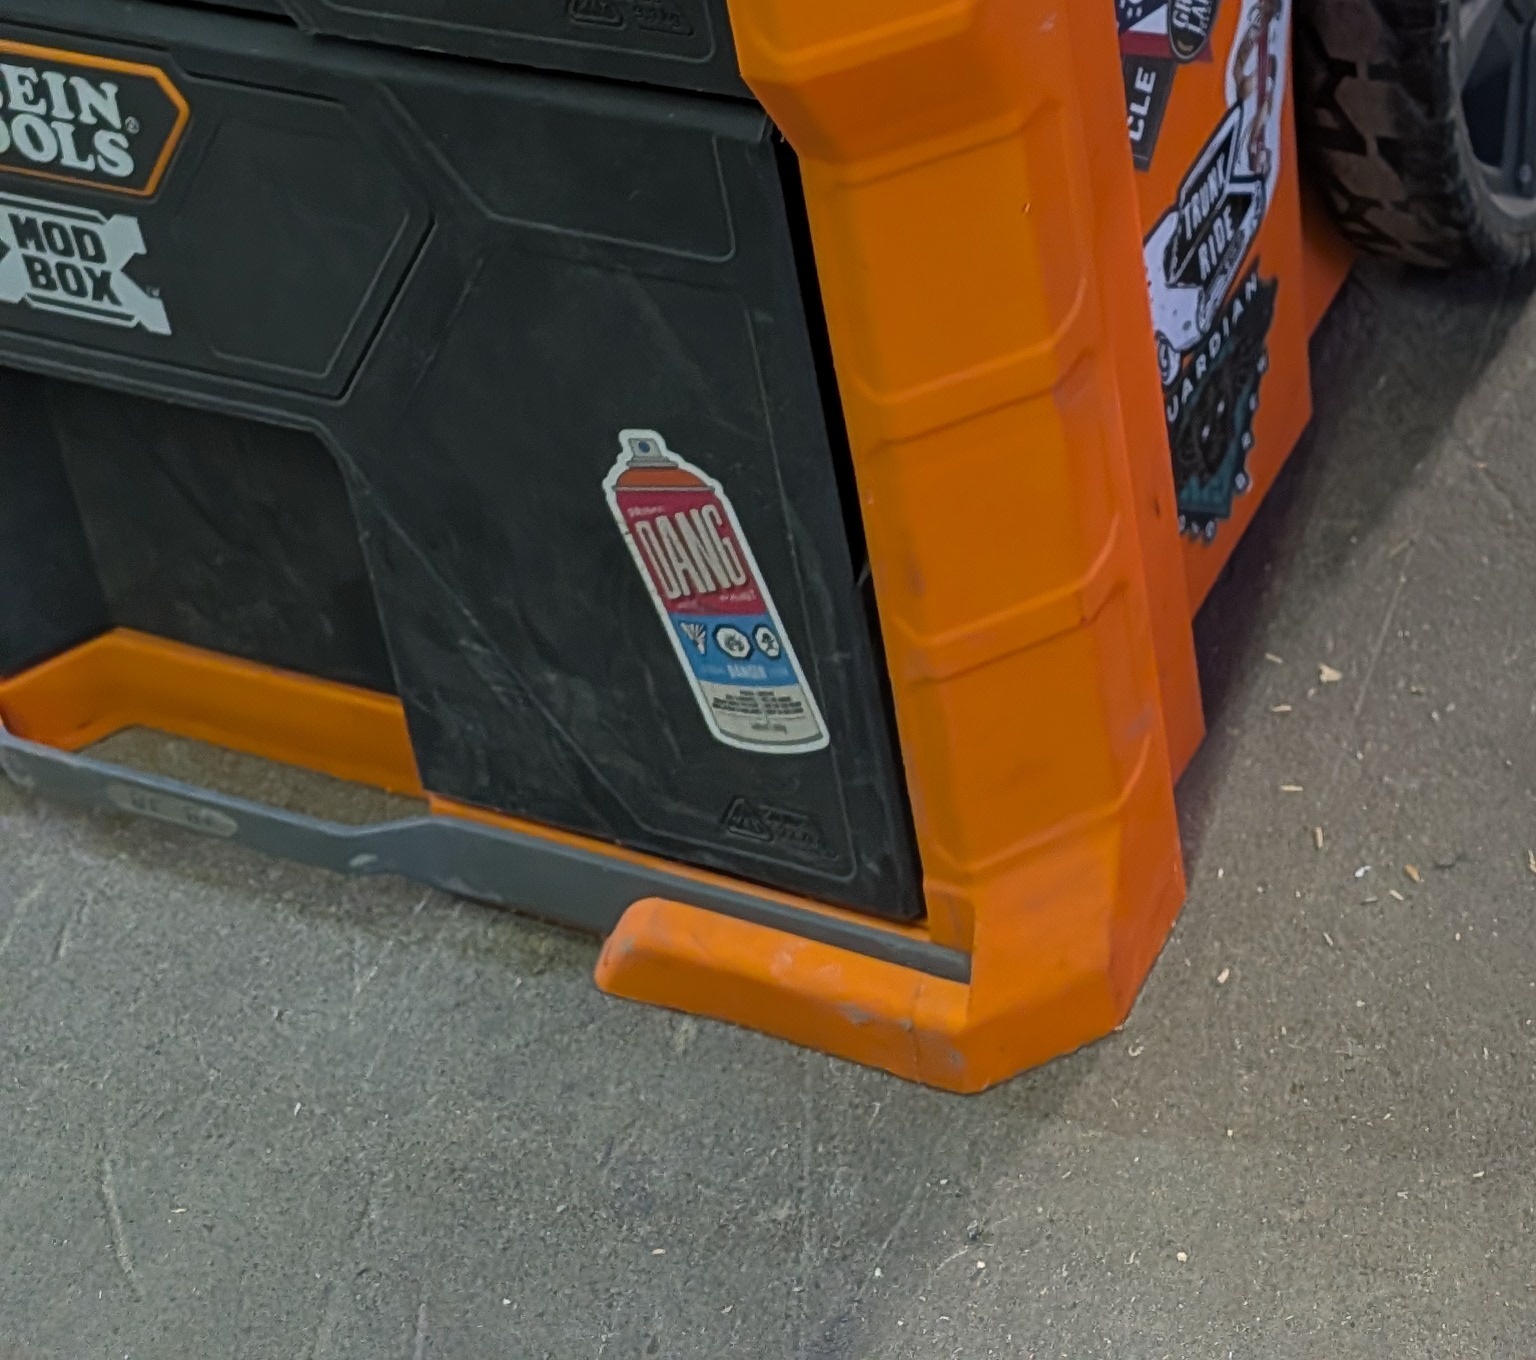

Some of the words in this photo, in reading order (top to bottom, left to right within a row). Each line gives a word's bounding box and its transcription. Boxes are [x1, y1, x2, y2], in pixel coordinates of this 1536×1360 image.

[0, 63, 122, 130] EIN
[1127, 67, 1156, 141] CLE
[0, 113, 135, 177] OLS
[8, 213, 107, 264] MOD
[1198, 205, 1233, 280] RIDE
[22, 254, 123, 306] BOX
[1167, 275, 1258, 422] UARDIAN
[636, 504, 746, 600] DANG
